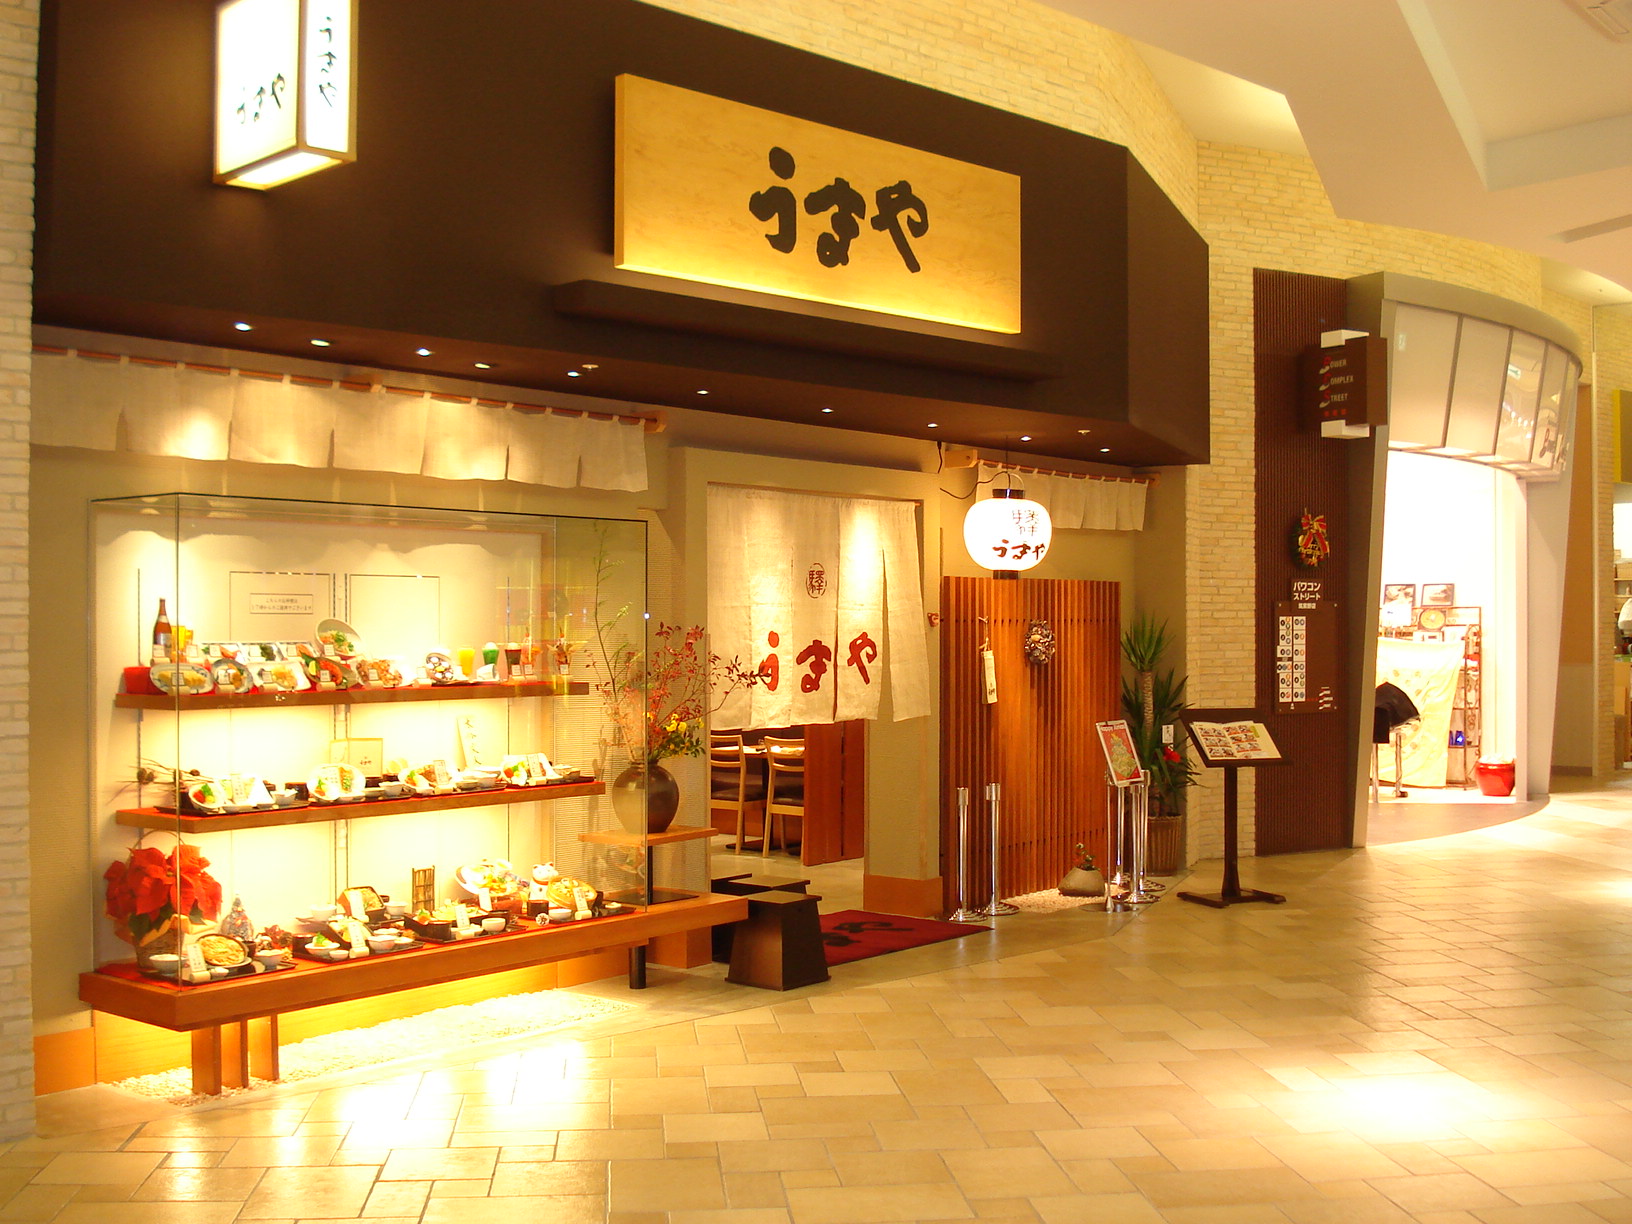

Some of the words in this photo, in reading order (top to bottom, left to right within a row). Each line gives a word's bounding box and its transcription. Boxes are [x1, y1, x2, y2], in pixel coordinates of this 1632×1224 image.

[748, 146, 929, 273] うまや
[992, 538, 1046, 561] うまや
[1293, 581, 1321, 591] パワコン
[1293, 592, 1321, 601] ストリート
[759, 630, 878, 694] うまや
